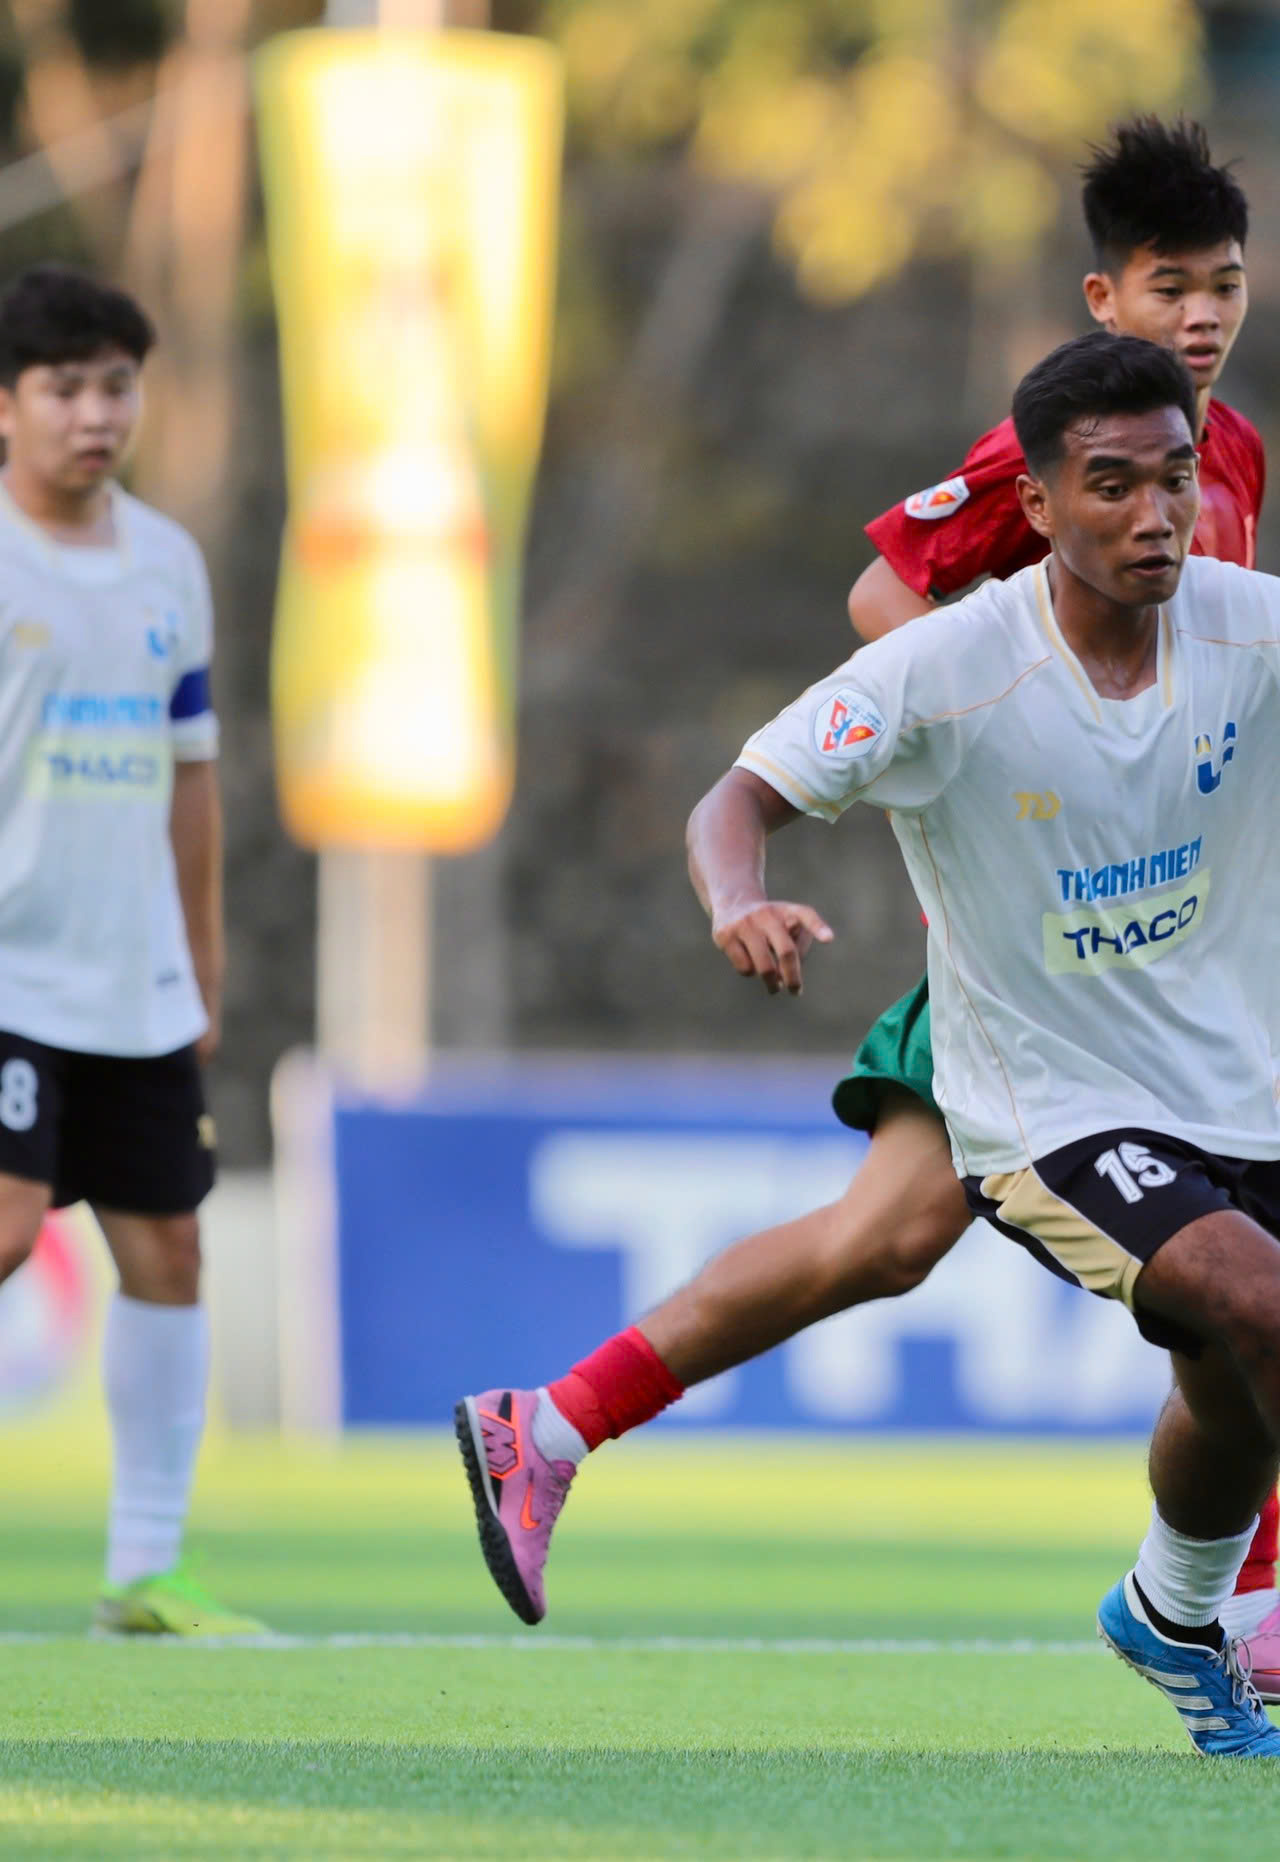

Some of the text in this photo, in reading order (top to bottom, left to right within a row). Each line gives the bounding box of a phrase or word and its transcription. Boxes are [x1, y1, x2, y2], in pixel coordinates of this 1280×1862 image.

[1056, 856, 1147, 902] THANH
[1063, 895, 1198, 960] THACO
[0, 1058, 38, 1132] 8
[1094, 1141, 1177, 1204] 15
